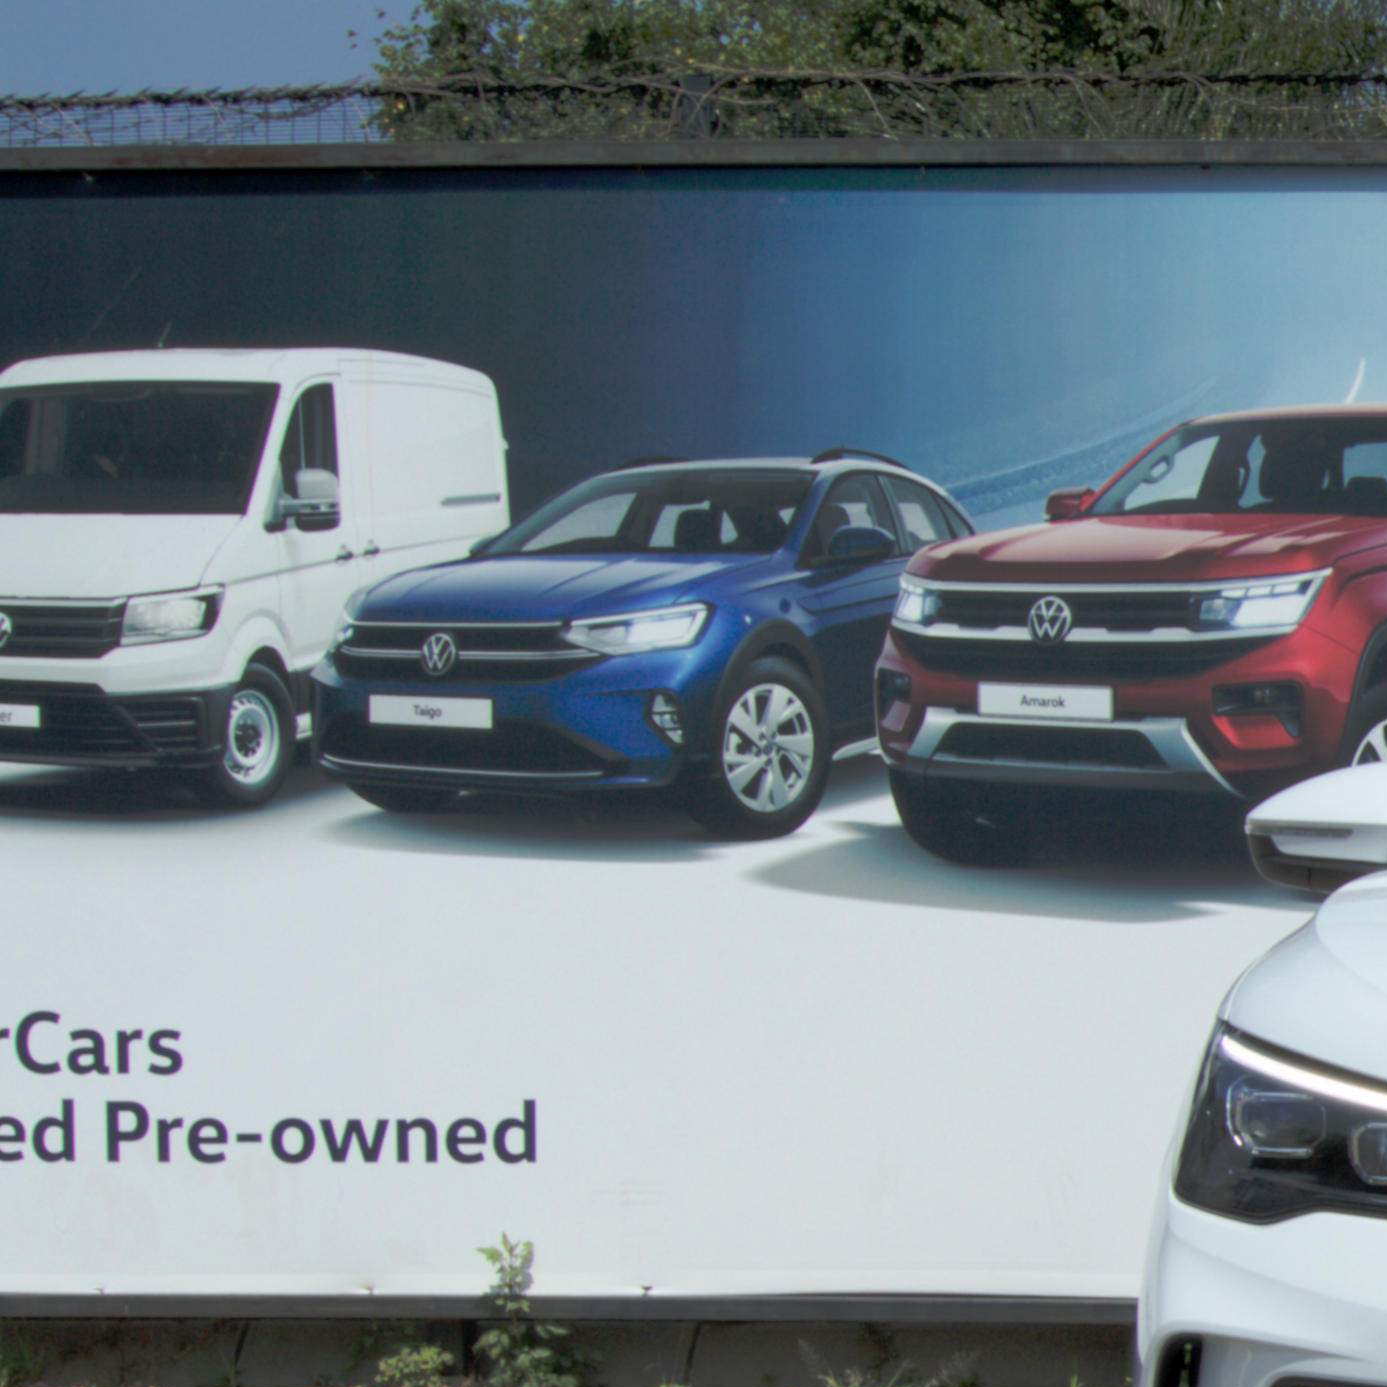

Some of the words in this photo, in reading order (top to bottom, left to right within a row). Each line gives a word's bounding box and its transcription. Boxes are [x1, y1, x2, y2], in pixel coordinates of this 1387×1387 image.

[1020, 694, 1065, 708] Amarok
[413, 704, 443, 721] Taigo
[105, 1098, 538, 1165] Pre-owned
